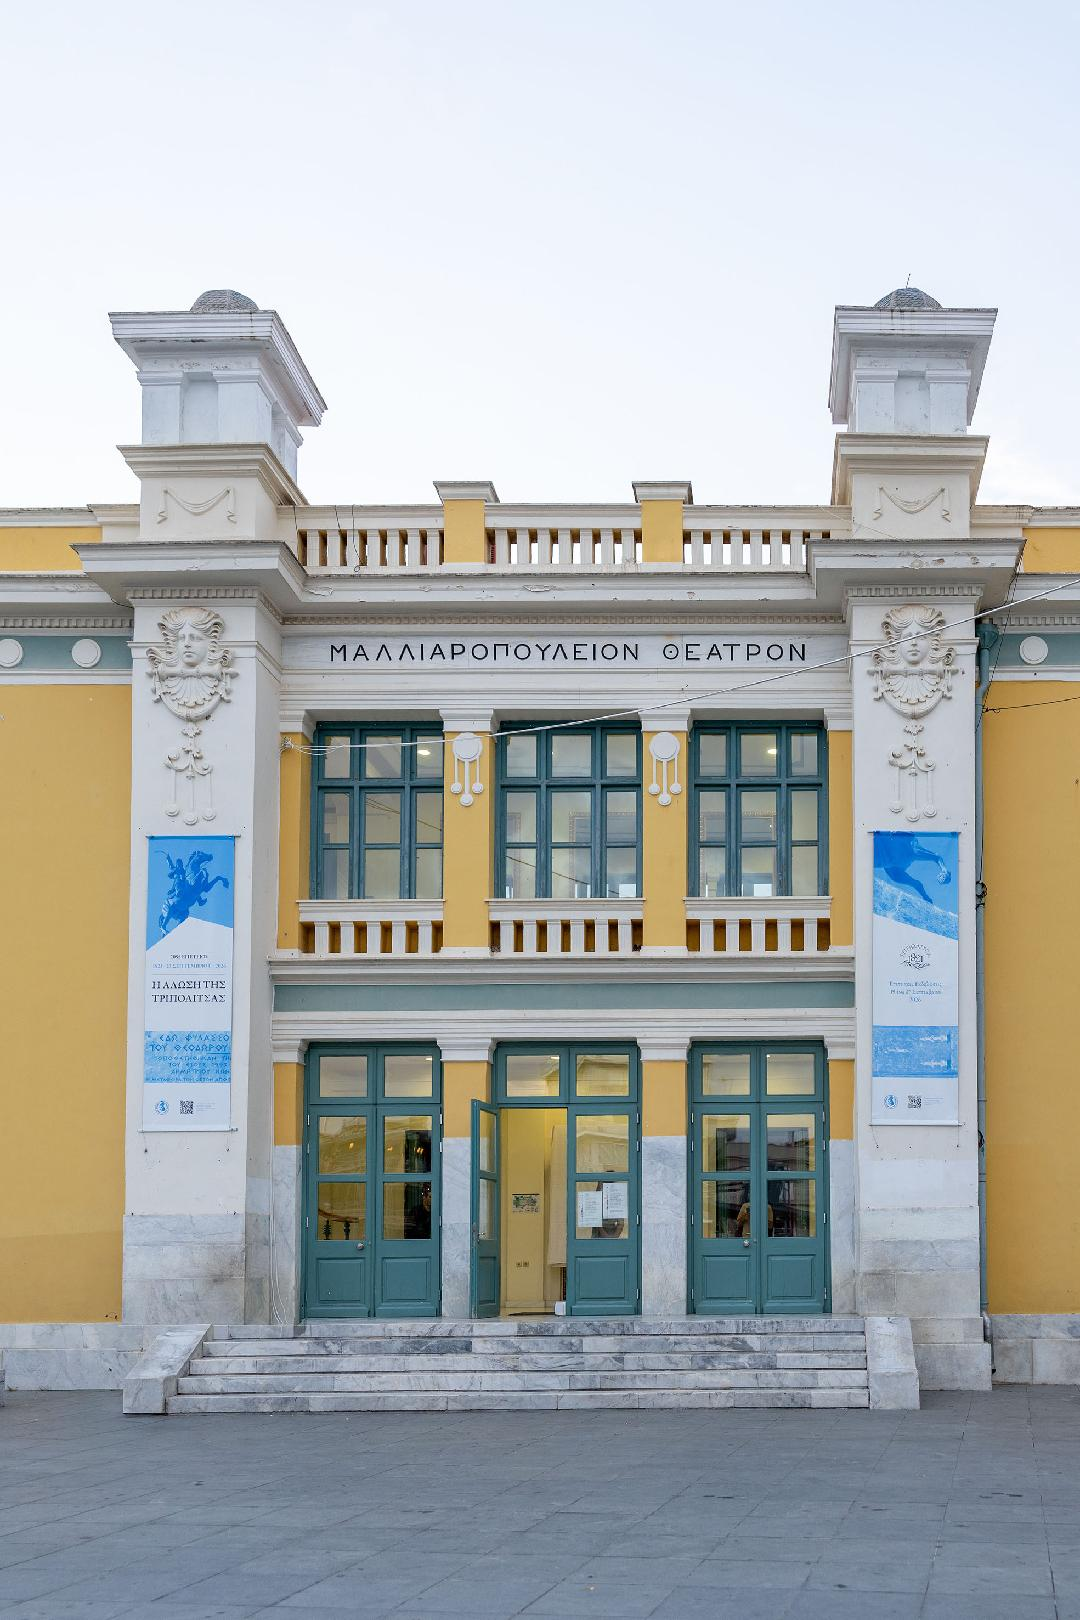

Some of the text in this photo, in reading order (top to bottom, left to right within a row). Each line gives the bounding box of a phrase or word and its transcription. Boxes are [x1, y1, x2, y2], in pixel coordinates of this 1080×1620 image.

[330, 643, 806, 661] ΜΑΛΛΙΑΡΟΠΟΥΛΕΙΟΝ ΘΕΑΤΡΟΝ
[203, 981, 226, 989] ΤΗΣ
[151, 994, 226, 1003] ΤΡΙΠΟΛΙΤΣΑΣ
